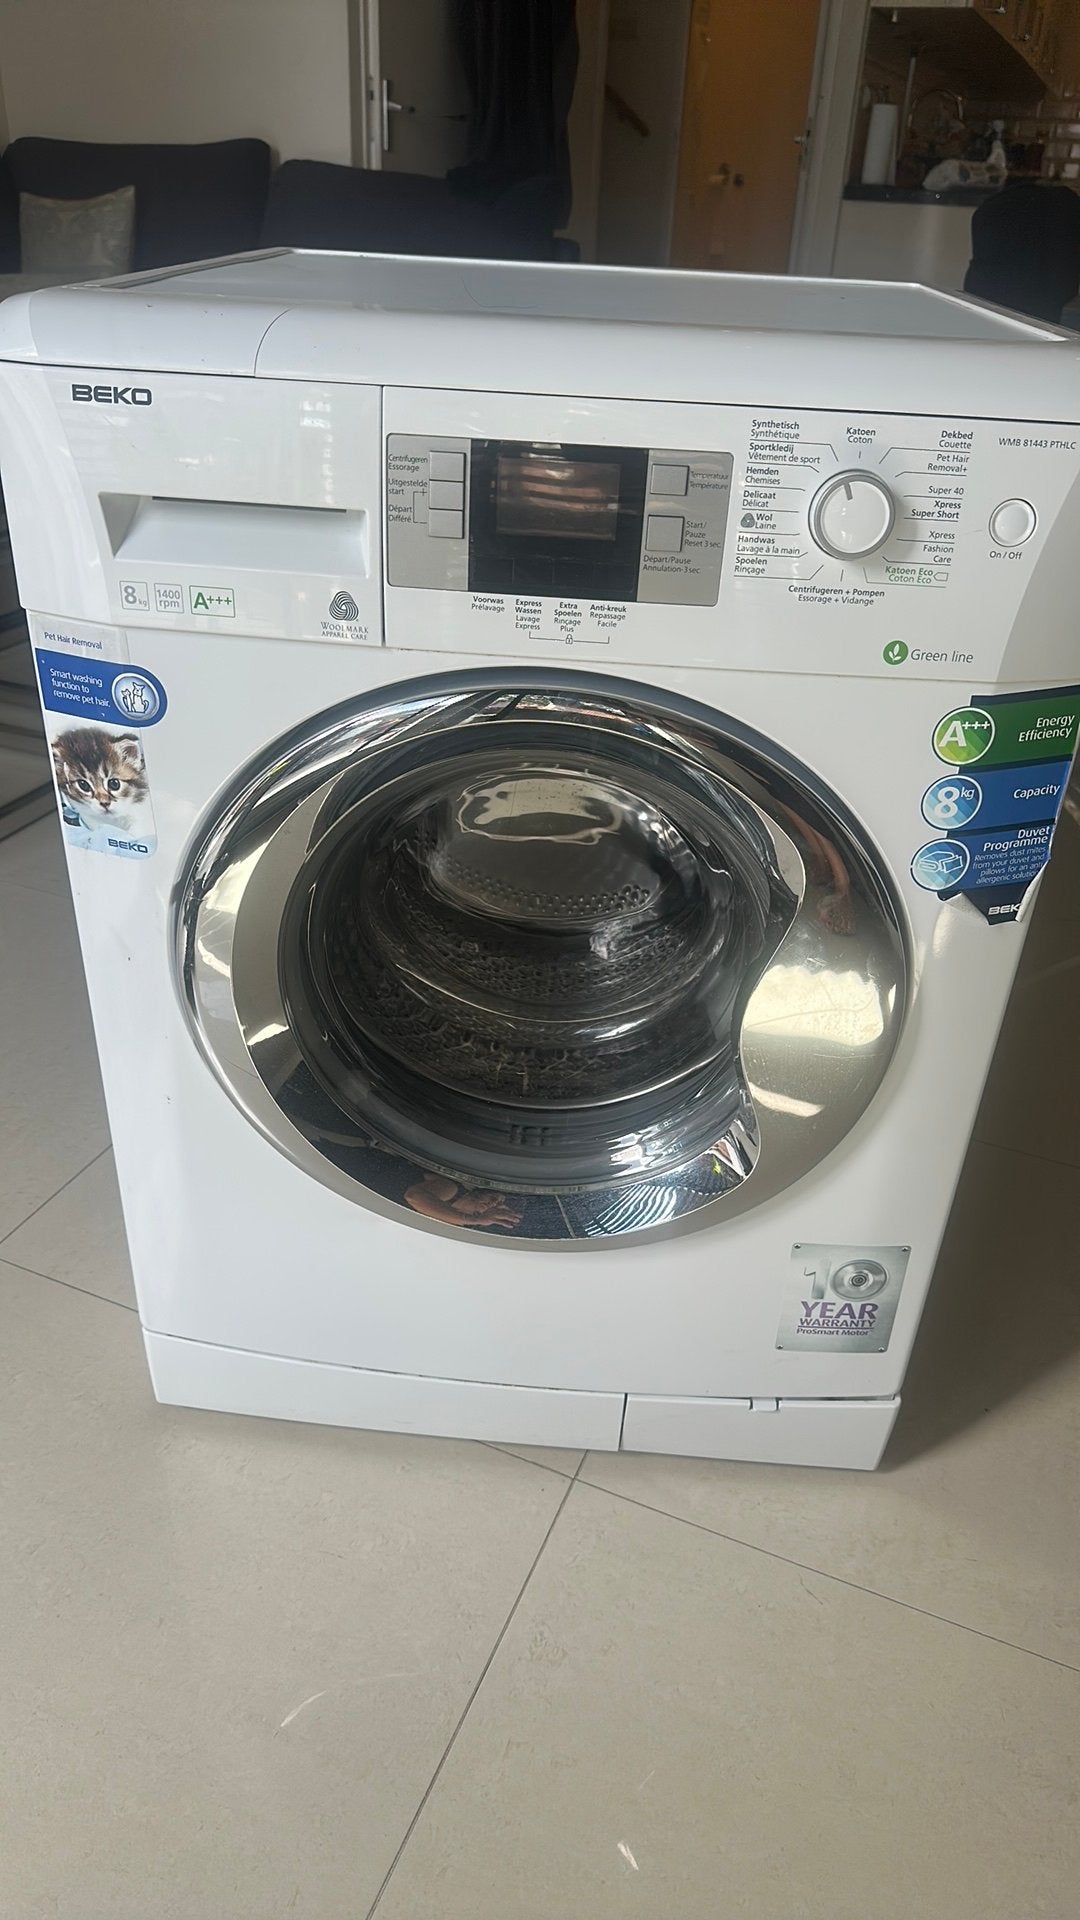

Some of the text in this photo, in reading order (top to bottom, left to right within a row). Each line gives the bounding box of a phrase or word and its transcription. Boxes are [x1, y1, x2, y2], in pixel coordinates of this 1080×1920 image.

[71, 384, 153, 406] BEKO
[752, 420, 800, 430] Synthetisch
[751, 429, 800, 440] Synthétique
[846, 427, 876, 436] Katoen
[941, 430, 973, 440] Dekbed
[847, 435, 873, 444] Coton
[939, 440, 972, 449] Couette
[999, 437, 1077, 450] WMB 81443 PTHLC
[749, 442, 794, 454] Sportkledij
[388, 453, 428, 464] Centrifugeren
[748, 452, 821, 465] Vêtement de sport
[936, 453, 970, 464] Pet Hair
[388, 463, 420, 473] Essorage
[746, 466, 779, 475] Hemden
[927, 463, 968, 473] Removal+
[388, 479, 428, 488] Uitgestelde
[745, 475, 780, 485] Chemises
[743, 490, 776, 499] Delicaat
[928, 485, 965, 496] Super 40
[742, 499, 769, 508] Délicat
[934, 500, 962, 510] Xpress
[388, 504, 413, 514] Départ
[911, 508, 960, 519] Super Short
[756, 513, 773, 521] Wol
[755, 521, 777, 530] Laine
[685, 530, 706, 540] Pauze
[738, 535, 776, 544] Handwas
[929, 530, 956, 541] Xpress
[737, 544, 800, 555] Lavage à la main
[923, 544, 954, 554] Fashion
[933, 554, 951, 564] Care
[989, 551, 1002, 559] On
[1008, 551, 1023, 560] Off
[735, 556, 768, 566] Spoelen
[734, 565, 766, 575] Rinçage
[885, 566, 934, 577] Katoen Eco
[888, 574, 932, 584] Coton Eco
[123, 585, 148, 608] 8 kg
[156, 589, 181, 600] 1400
[788, 584, 844, 596] Centrifugeren
[852, 588, 885, 600] Pompen
[159, 599, 180, 609] rpm
[193, 591, 232, 610] A+++
[473, 596, 504, 605] Voorwas
[515, 599, 542, 608] Express
[559, 601, 578, 610] Extra
[798, 594, 833, 604] Essorage
[841, 596, 875, 608] Vidange
[471, 603, 505, 613] Prélavage
[515, 607, 542, 615] Wassen
[554, 608, 582, 618] Spoelen
[589, 603, 627, 613] Anti-kreuk
[515, 615, 541, 624] Lavage
[589, 611, 626, 621] Repassage
[515, 622, 541, 631] Express
[554, 617, 581, 627] Rinçage
[597, 619, 617, 628] Facile
[560, 625, 575, 633] Plus
[44, 631, 102, 650] Pet Hair Removal
[350, 633, 368, 641] CARE
[910, 648, 974, 664] Green line
[50, 668, 103, 688] Smart washing
[52, 678, 90, 693] function to
[54, 690, 111, 708] remove pet hair.
[1036, 715, 1075, 728] Energy
[938, 720, 990, 747] A+++
[1018, 727, 1073, 743] Efficiency
[1013, 784, 1061, 799] Capacity
[934, 786, 975, 817] 8 kg
[1017, 825, 1050, 839] Duvet
[107, 838, 148, 854] BEKO
[983, 834, 1048, 852] Programme
[974, 846, 1046, 862] Removes dust mites
[972, 852, 1045, 870] from your duvet and
[980, 867, 1006, 878] pillows
[1007, 865, 1019, 873] for
[975, 874, 1011, 885] allergenic
[988, 903, 1021, 915] BEK
[800, 1300, 879, 1320] YEAR
[800, 1318, 876, 1327] WARRANTY
[796, 1328, 840, 1337] ProSmart
